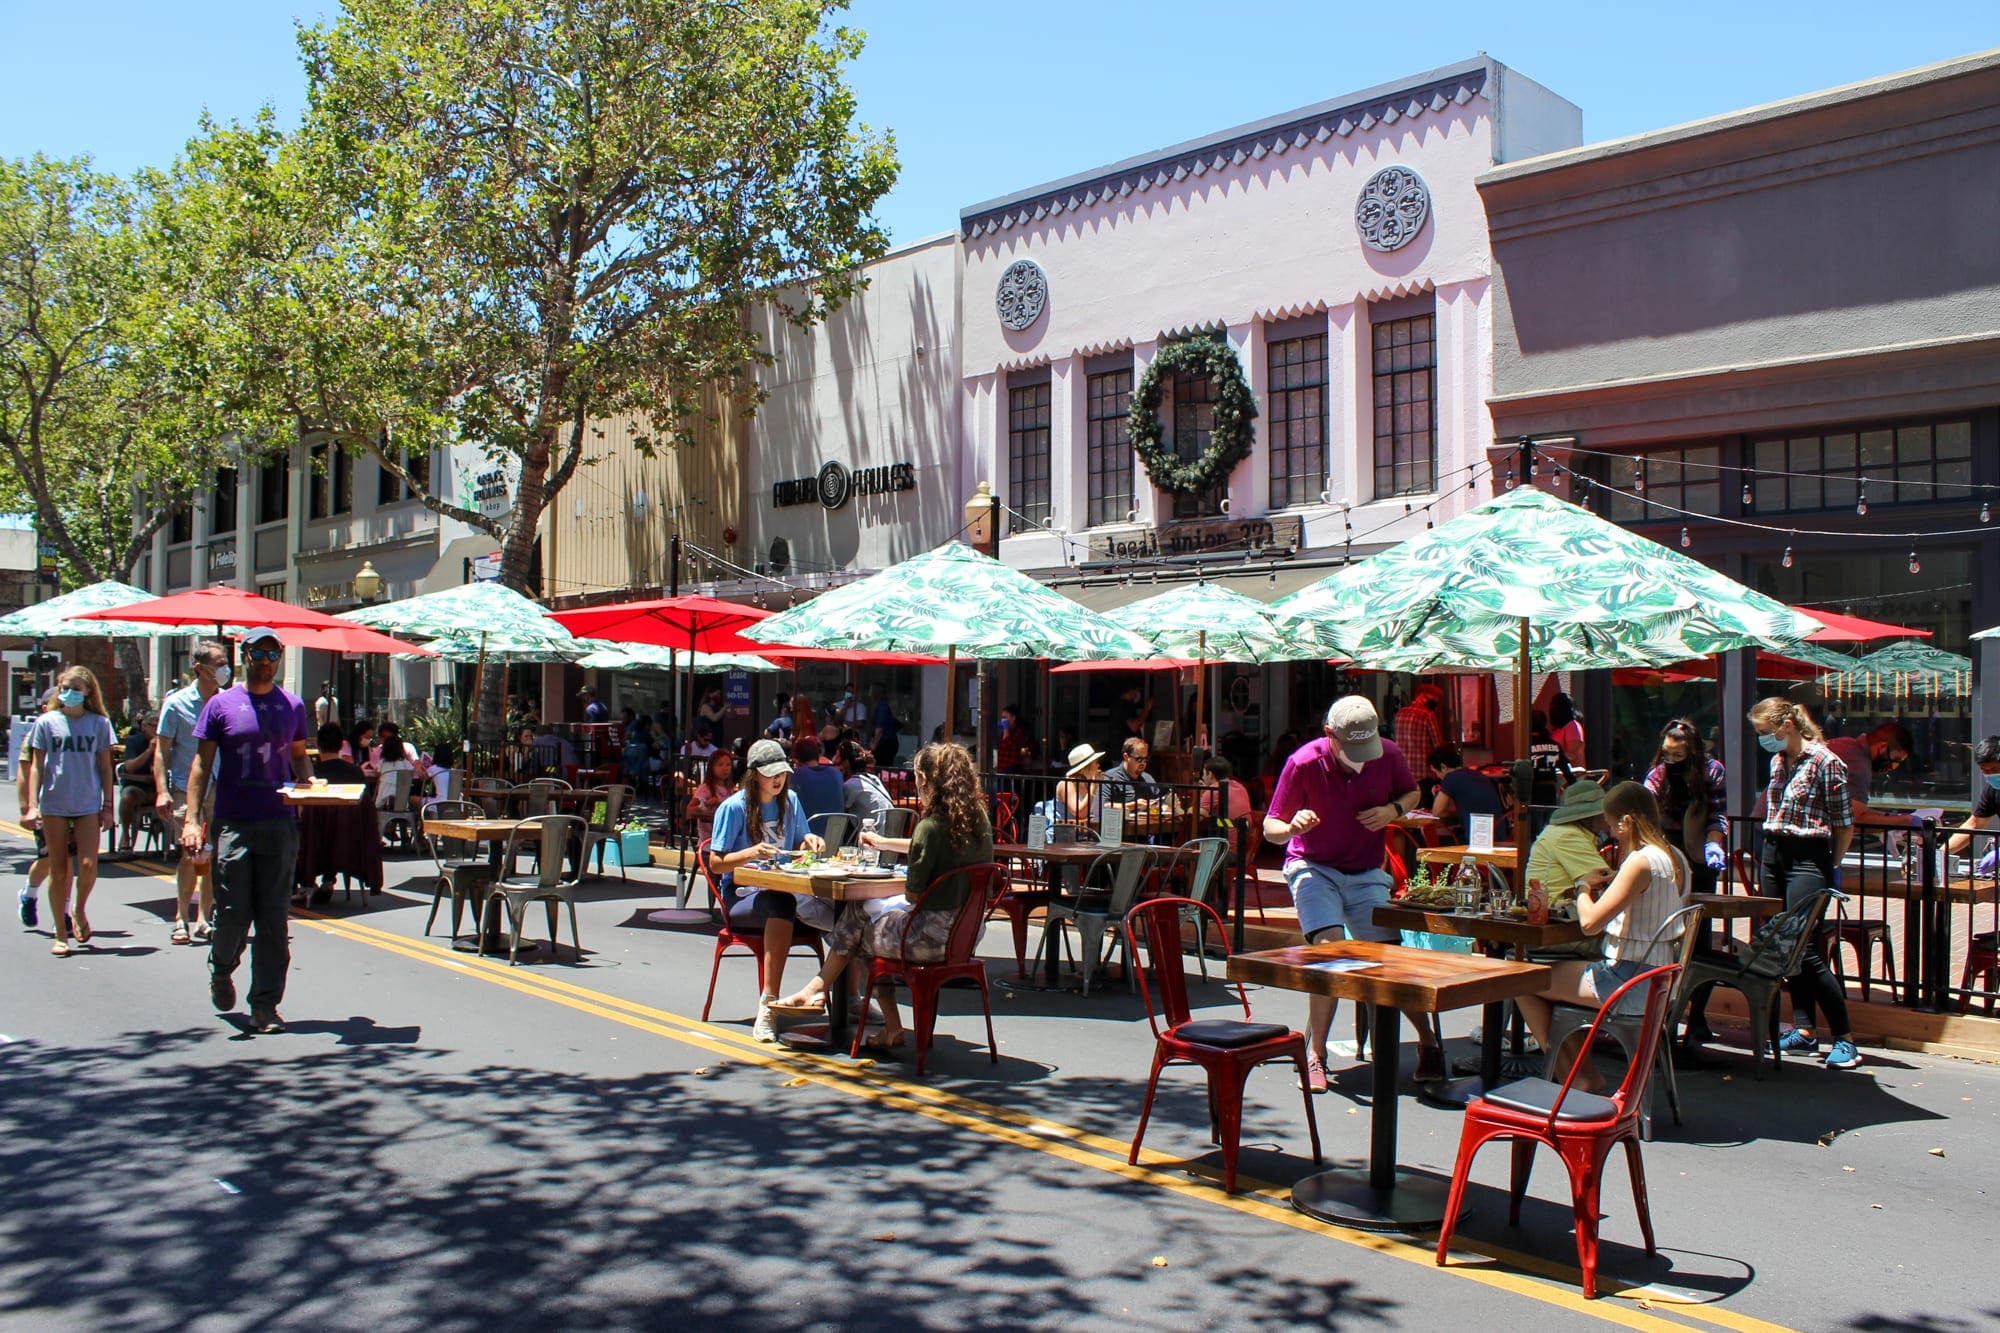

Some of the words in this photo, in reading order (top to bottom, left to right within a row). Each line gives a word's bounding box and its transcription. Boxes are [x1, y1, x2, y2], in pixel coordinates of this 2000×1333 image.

[1105, 529, 1158, 557] local
[1170, 534, 1228, 552] union
[1239, 521, 1275, 547] 271
[729, 671, 747, 680] Lease
[52, 735, 96, 752] PALY
